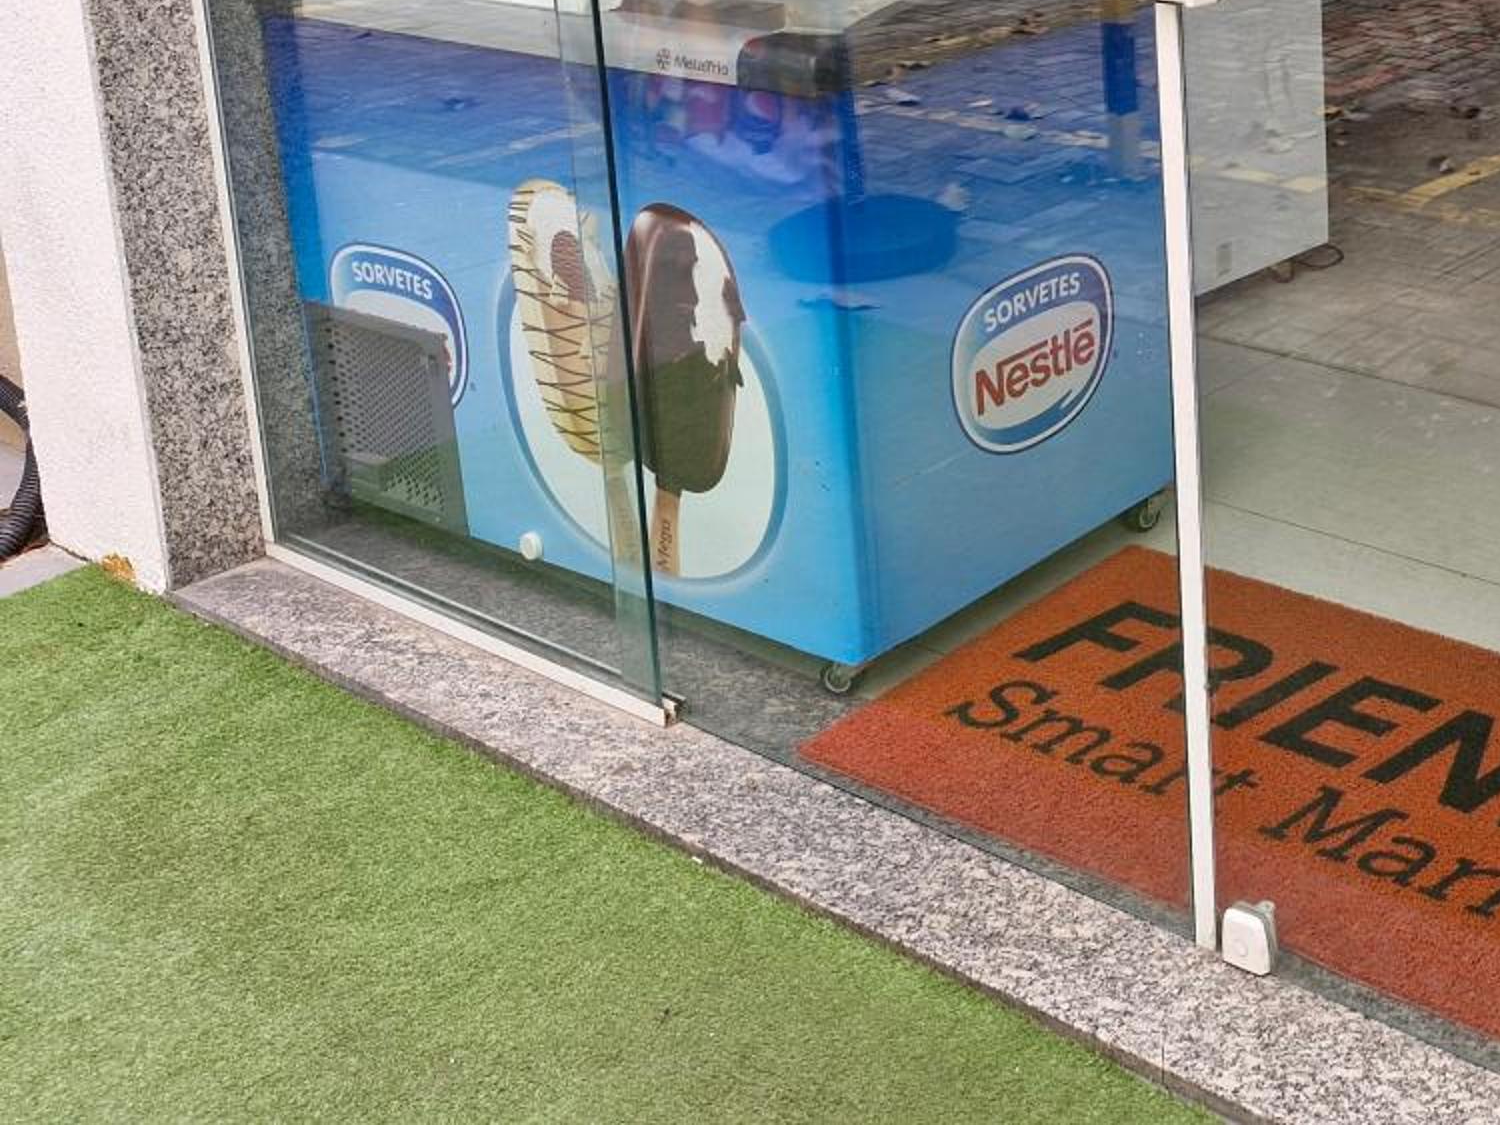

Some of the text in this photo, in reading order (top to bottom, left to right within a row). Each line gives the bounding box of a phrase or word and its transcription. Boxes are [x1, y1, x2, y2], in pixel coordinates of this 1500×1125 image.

[351, 261, 433, 300] SORVETES
[984, 271, 1081, 333] SORVETES
[974, 318, 1097, 416] Nestlé
[944, 679, 1259, 797] Smart
